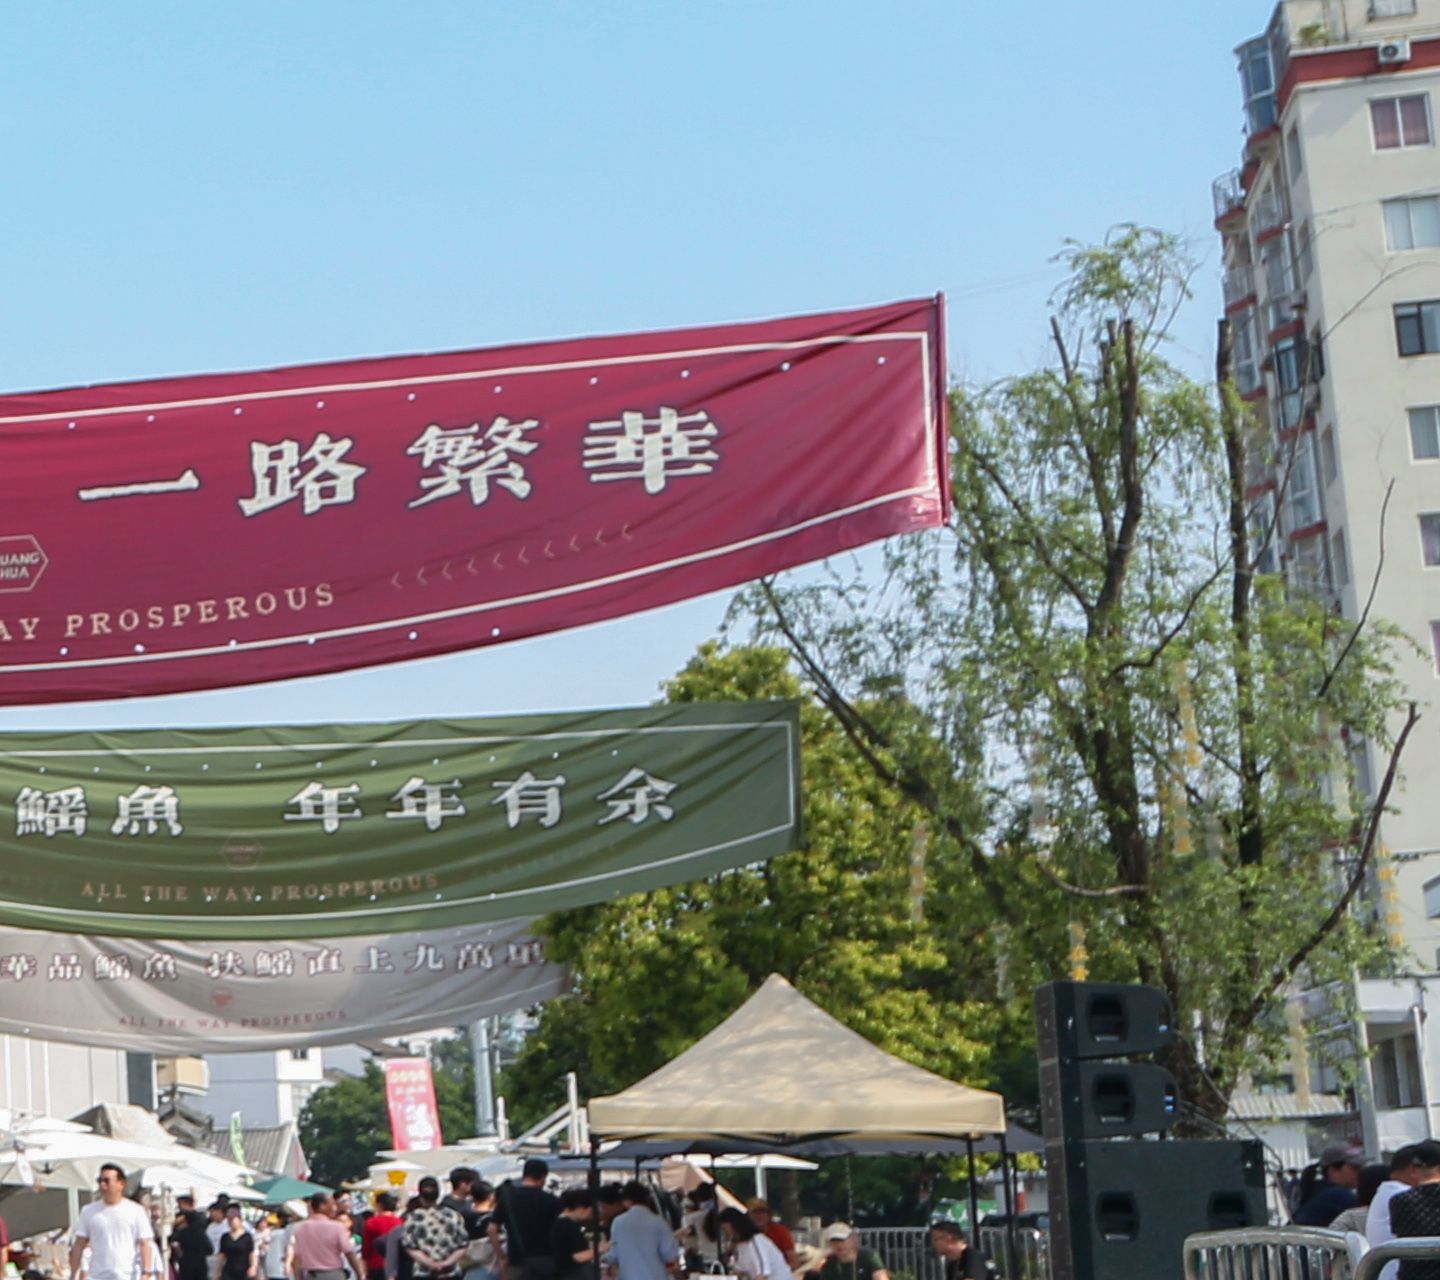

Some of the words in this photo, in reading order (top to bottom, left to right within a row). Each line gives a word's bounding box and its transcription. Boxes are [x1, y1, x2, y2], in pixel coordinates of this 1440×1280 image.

[77, 406, 721, 517] 一路繁華
[0, 567, 30, 580] HUA
[64, 582, 335, 638] PROSPEROUS
[283, 766, 678, 835] 年年有余
[81, 881, 128, 900] ALL
[141, 884, 189, 902] THE
[201, 886, 257, 903] WAY
[271, 873, 440, 901] PROSPEROUS
[118, 1015, 148, 1028] ALL
[157, 1016, 188, 1029] THE
[198, 1017, 231, 1029] WAY
[240, 1009, 348, 1029] PROSPEROUS
